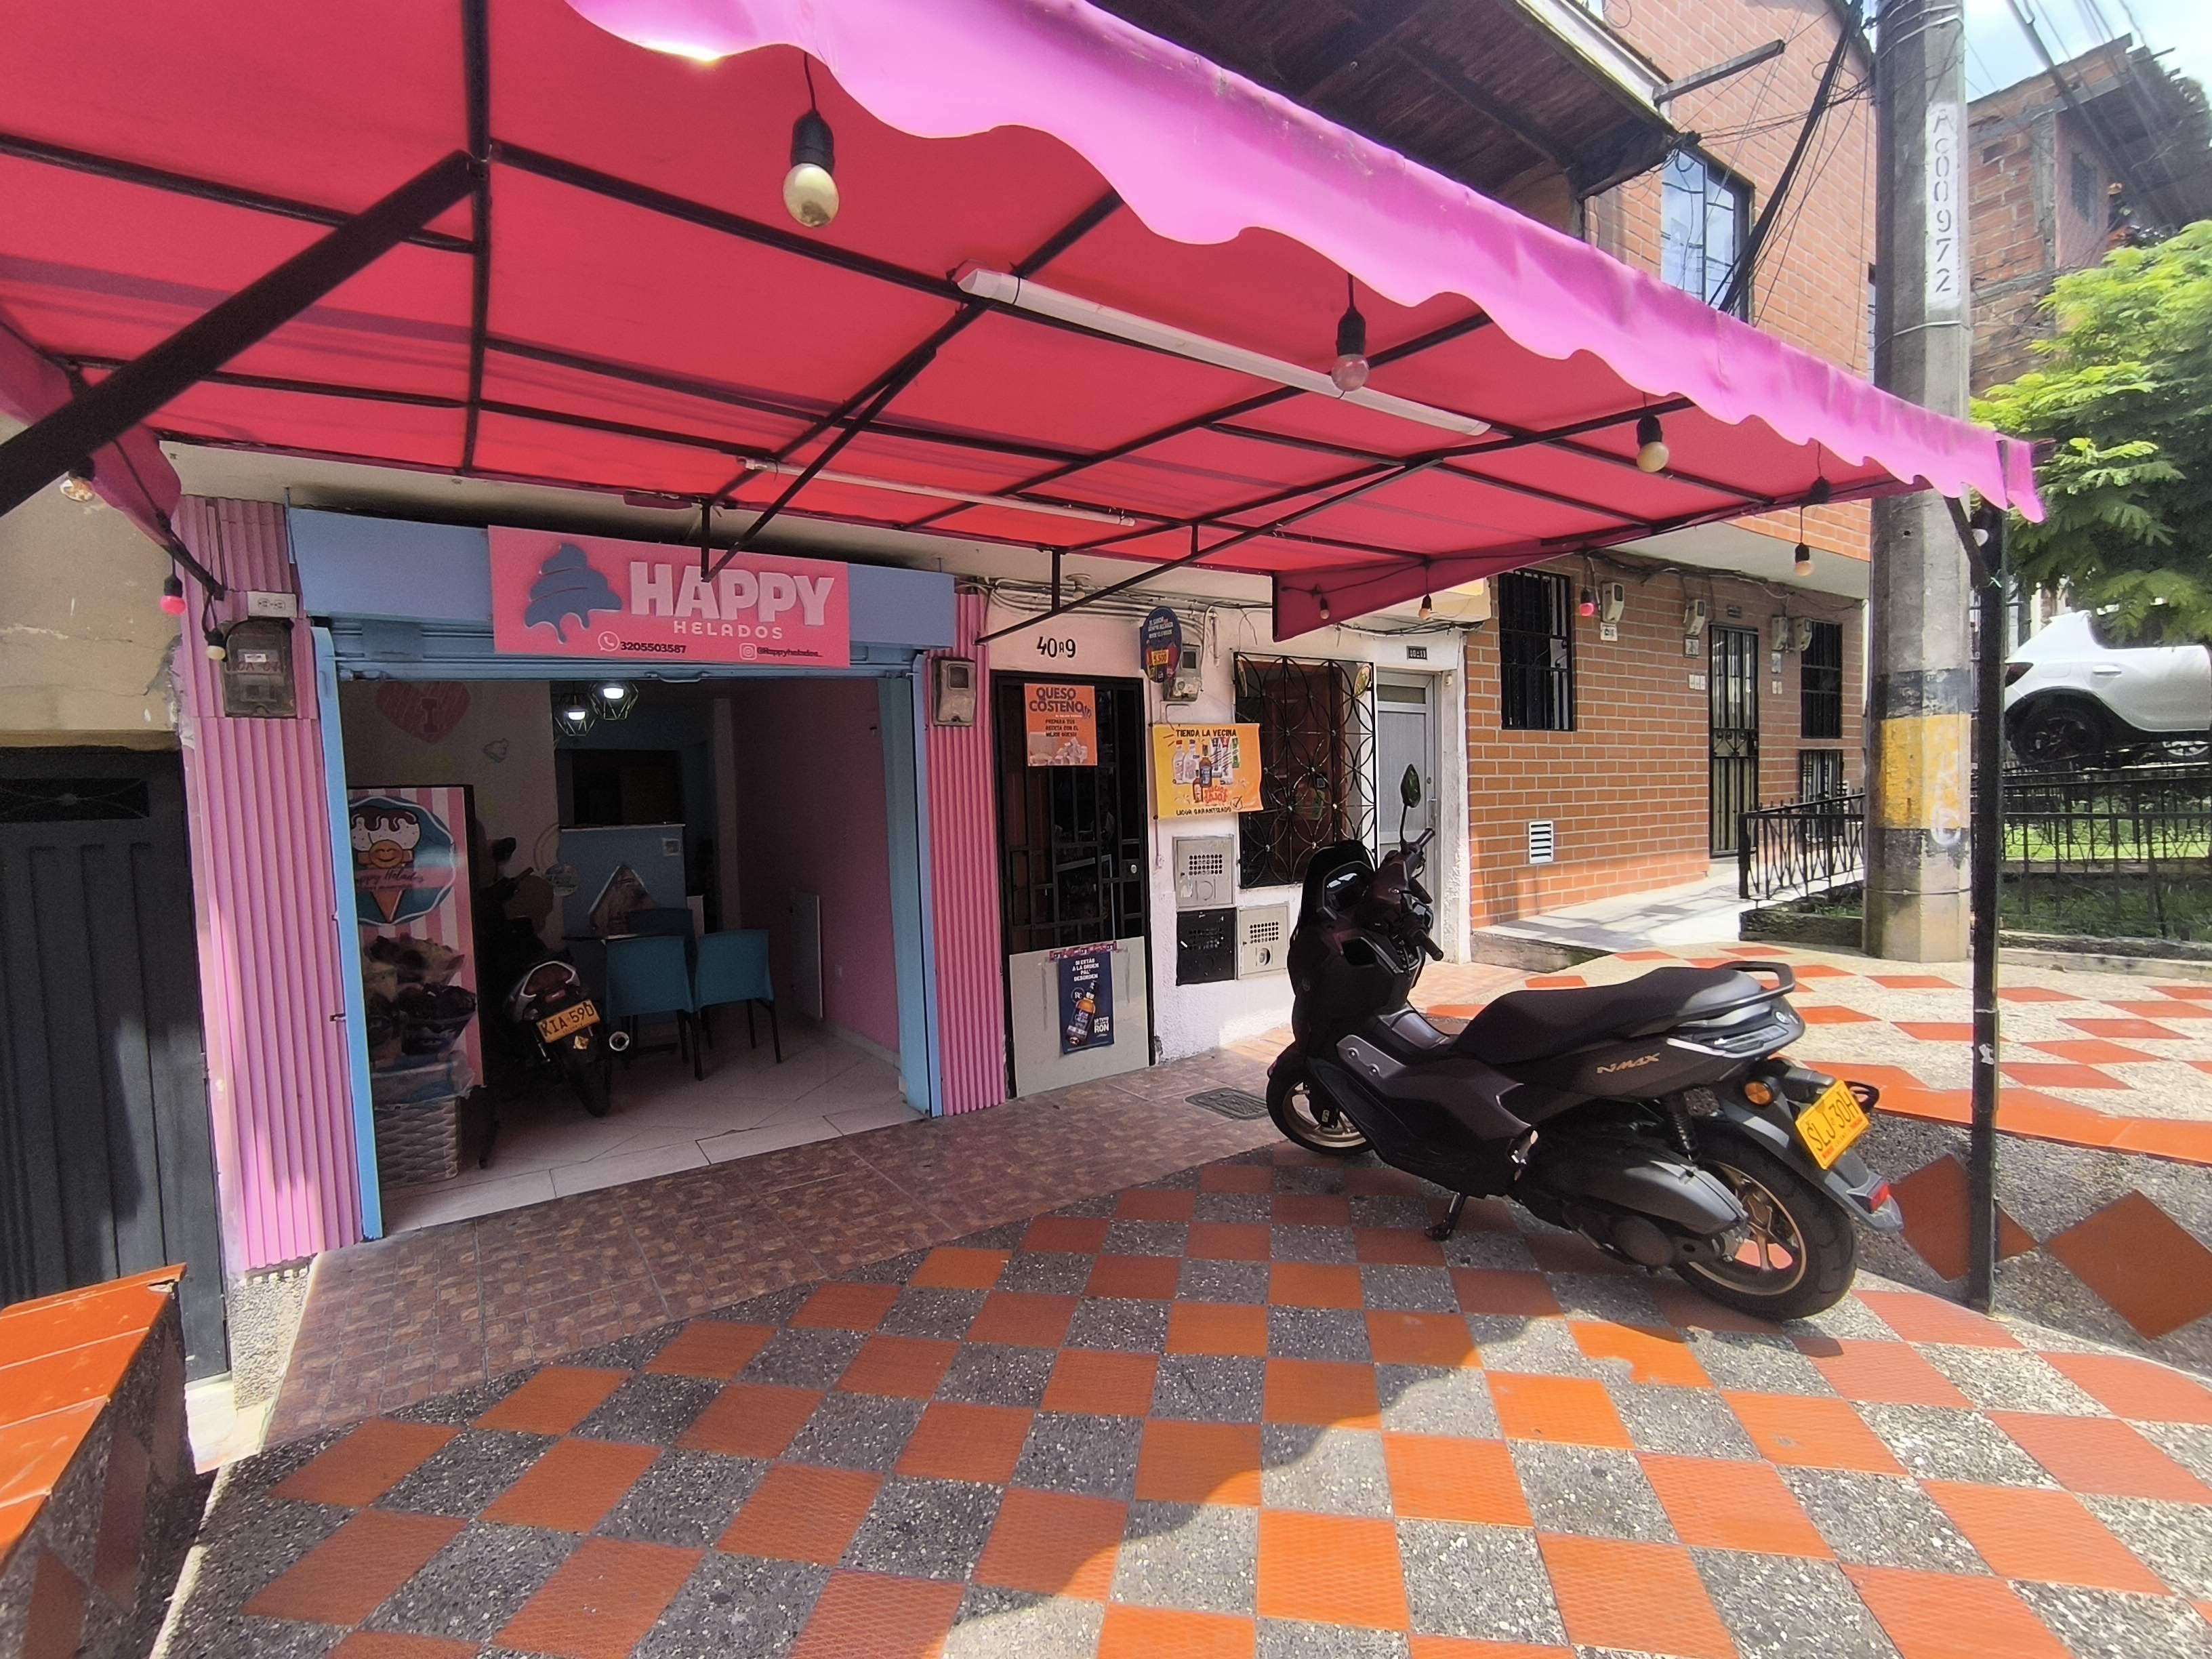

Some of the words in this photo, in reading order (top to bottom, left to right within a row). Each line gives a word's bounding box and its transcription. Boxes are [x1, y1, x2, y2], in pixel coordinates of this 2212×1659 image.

[630, 561, 835, 626] HAPPY
[674, 620, 783, 640] HELADOS
[620, 641, 687, 654] 3205503587
[1036, 687, 1076, 701] QUESO
[1176, 729, 1200, 737] TIENDA
[1094, 1023, 1109, 1033] RON
[1596, 1052, 1660, 1074] NMAX
[1807, 1112, 1836, 1151] SLJ
[1828, 1091, 1860, 1129] 30H
